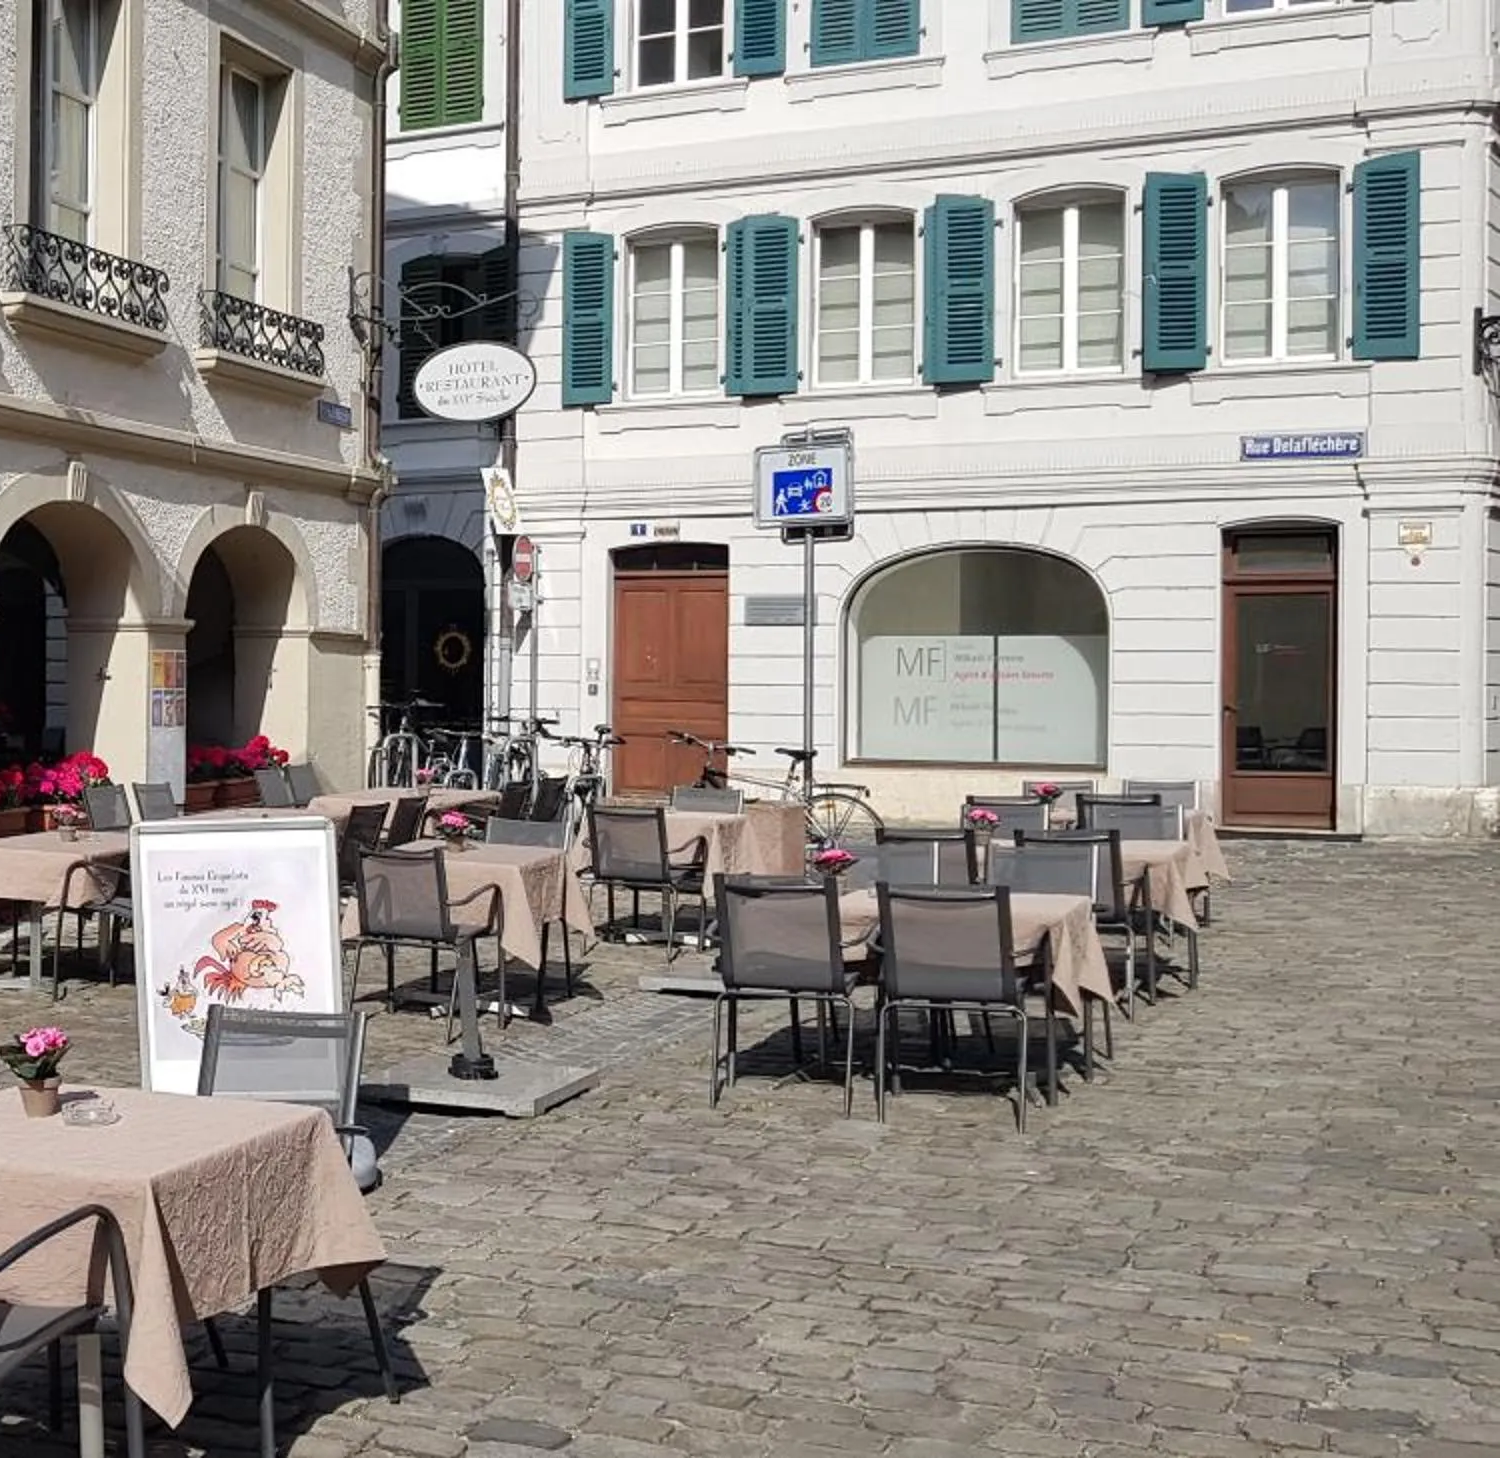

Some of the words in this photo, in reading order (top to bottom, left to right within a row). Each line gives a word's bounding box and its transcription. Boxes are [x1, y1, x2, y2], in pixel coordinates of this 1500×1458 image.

[425, 374, 523, 392] RESTAURANT
[1245, 439, 1270, 455] Rue
[1273, 436, 1358, 453] Delafléchère
[787, 452, 817, 466] ZONE
[896, 647, 942, 677] MF
